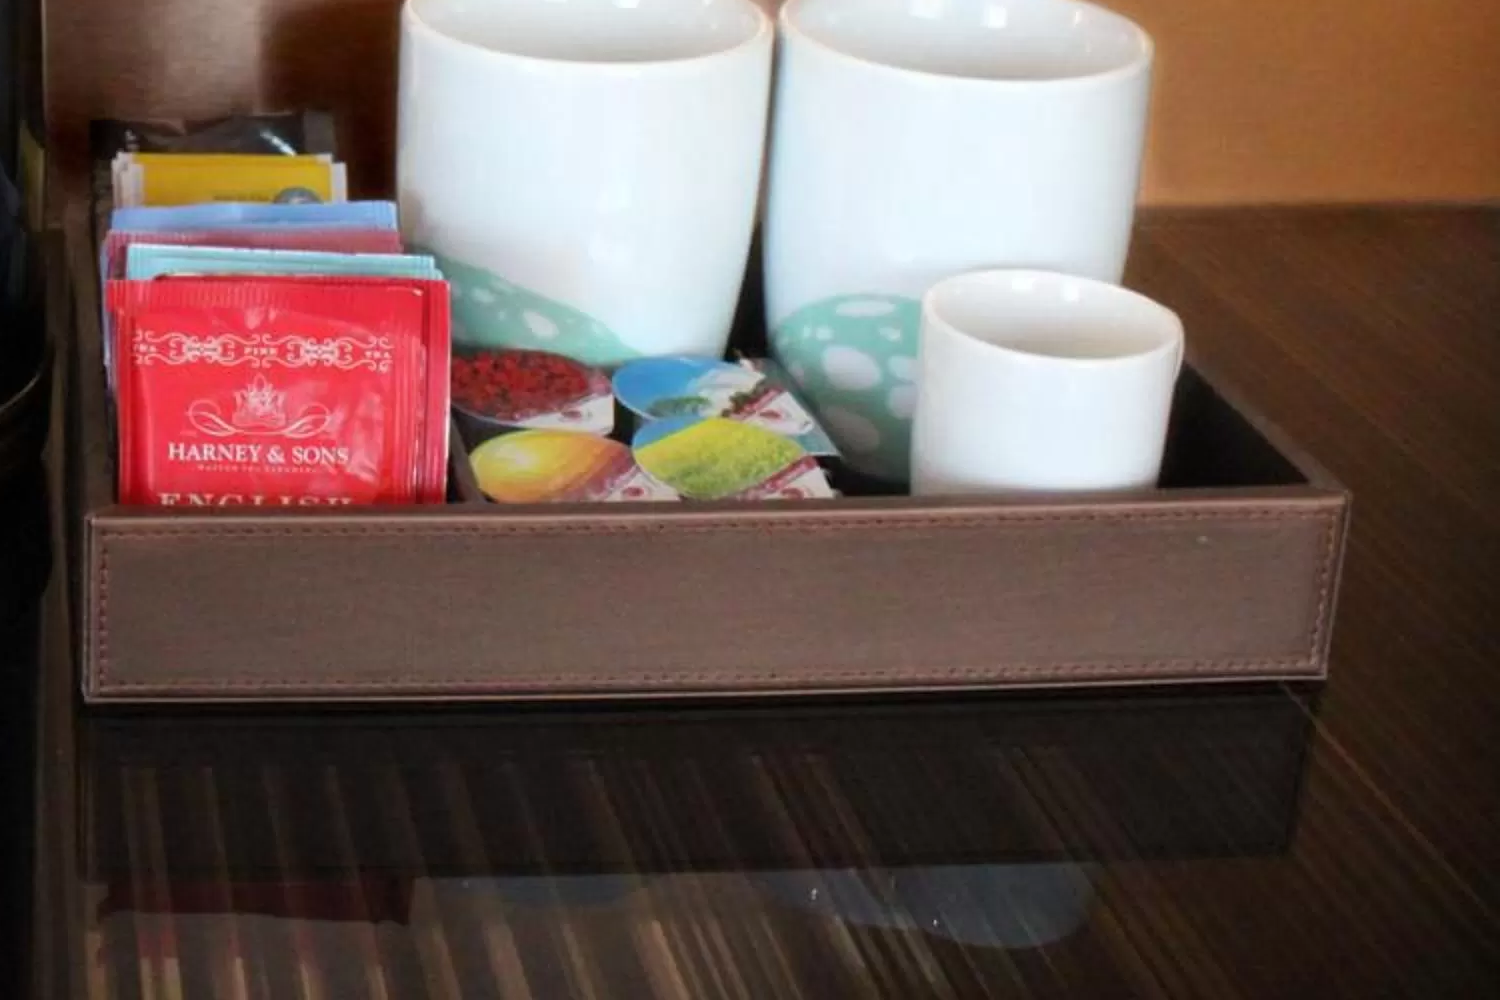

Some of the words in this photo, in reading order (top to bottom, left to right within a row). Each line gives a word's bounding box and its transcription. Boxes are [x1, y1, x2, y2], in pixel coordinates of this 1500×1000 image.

[168, 442, 261, 463] HARNEY
[267, 445, 285, 464] &
[292, 446, 350, 466] SONS
